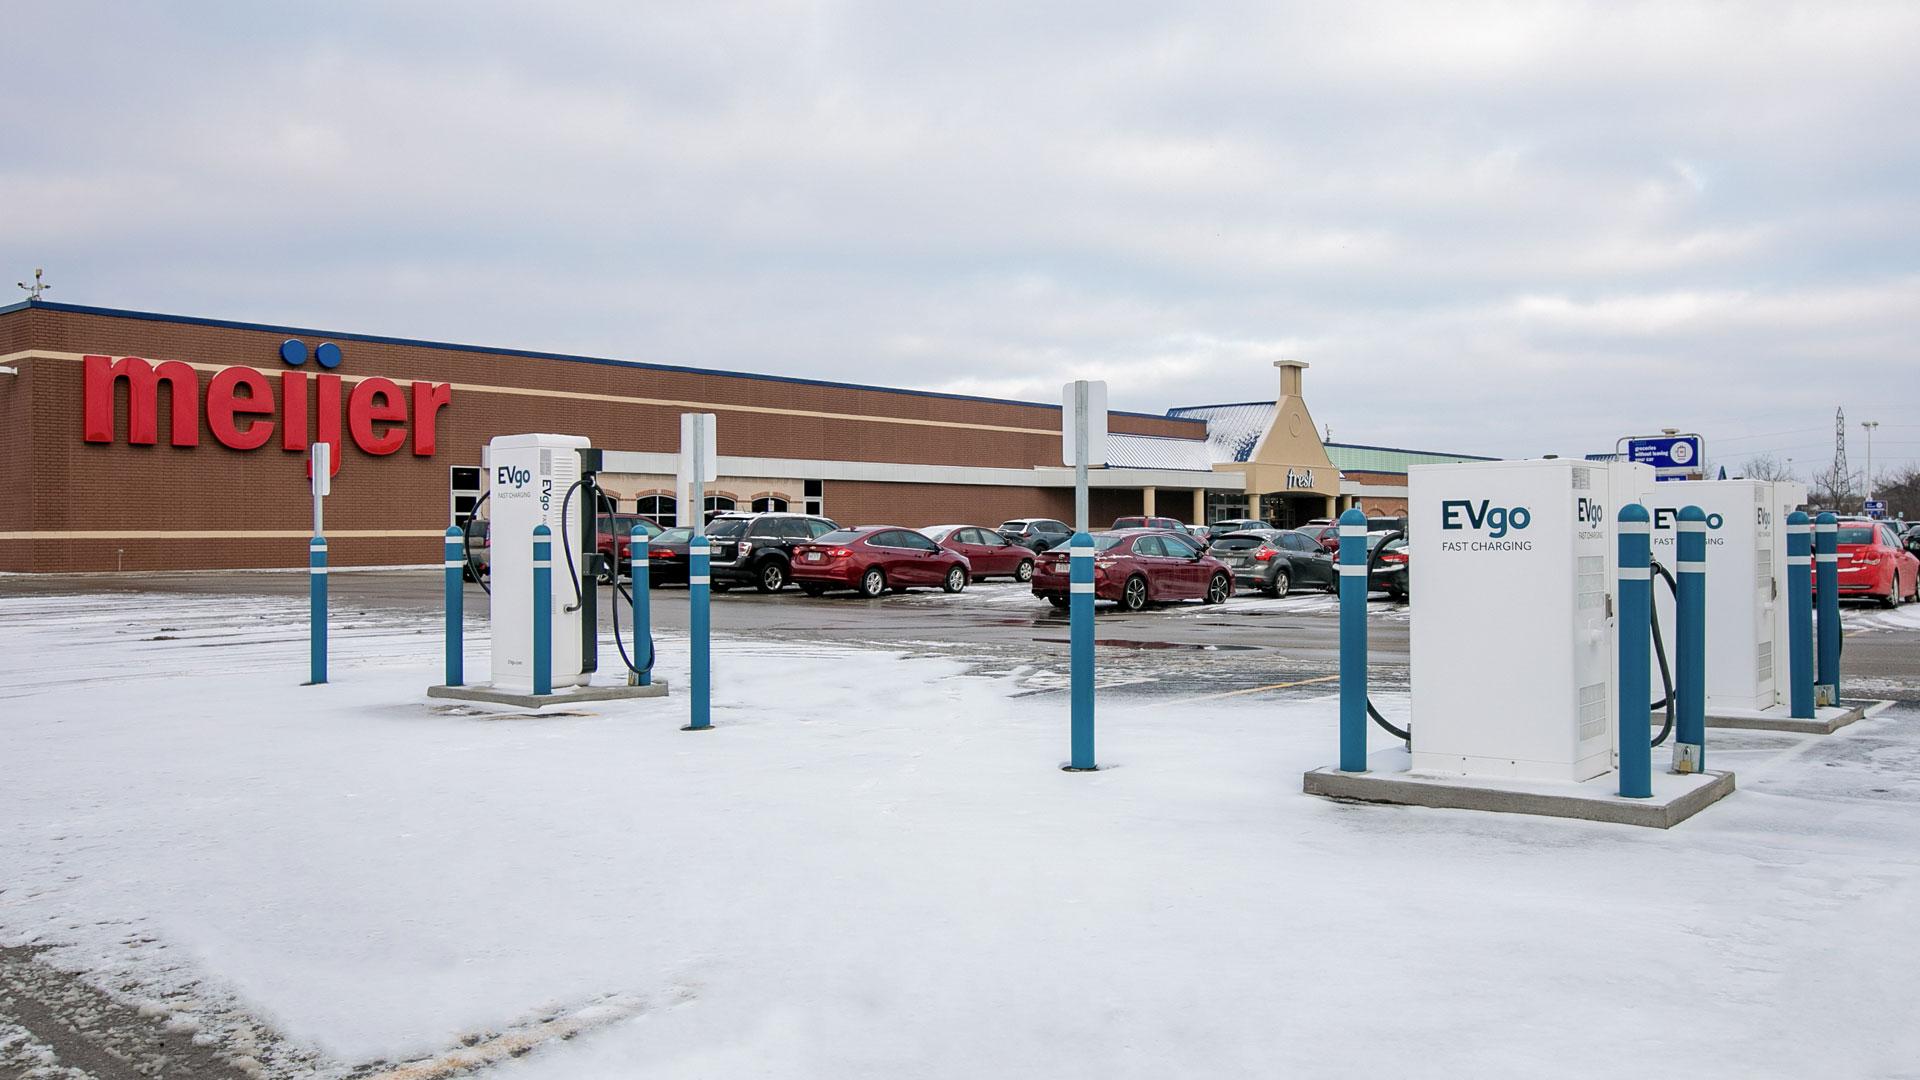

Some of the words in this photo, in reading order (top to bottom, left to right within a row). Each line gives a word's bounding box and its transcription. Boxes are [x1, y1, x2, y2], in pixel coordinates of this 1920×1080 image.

[83, 338, 451, 481] meijer
[498, 465, 531, 489] EVgo
[1287, 468, 1314, 490] fresh
[540, 479, 552, 511] EVgo
[1442, 499, 1531, 539] EVgo
[1578, 497, 1603, 529] EVgo
[1654, 508, 1724, 530] Eo
[1757, 507, 1771, 530] EVgo
[1442, 541, 1469, 551] FAST
[1471, 541, 1532, 551] CHARGING
[1654, 537, 1675, 546] FAST
